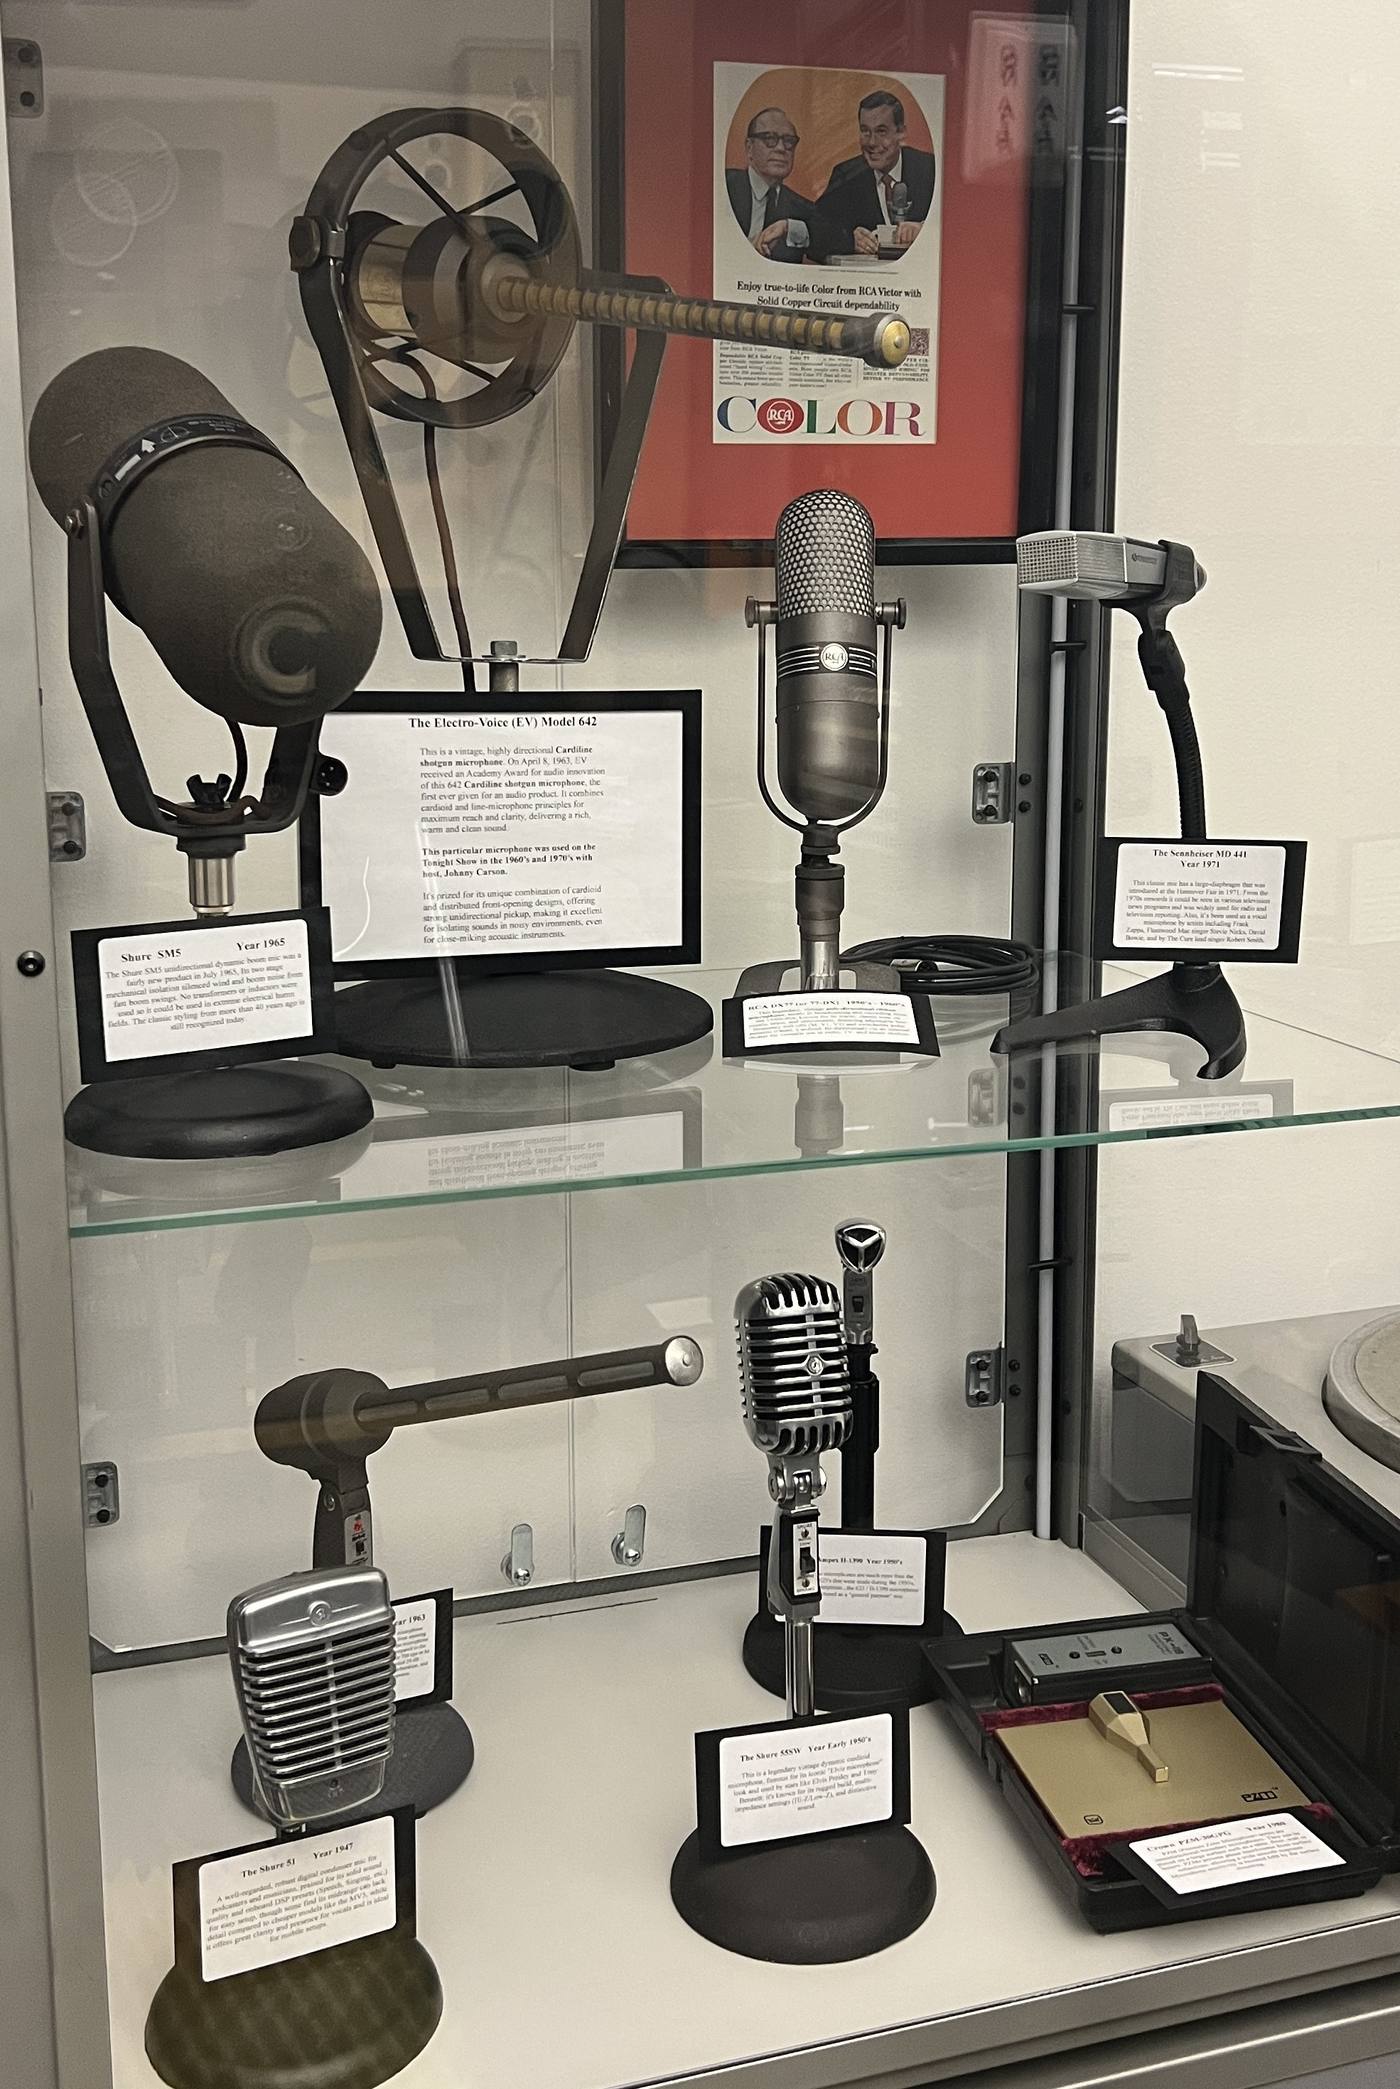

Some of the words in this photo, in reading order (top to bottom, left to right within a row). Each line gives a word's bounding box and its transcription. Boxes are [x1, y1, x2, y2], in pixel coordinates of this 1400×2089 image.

[737, 281, 762, 293] Enjoy
[764, 282, 810, 293] true-to-life
[812, 284, 835, 294] Color
[836, 285, 857, 295] from
[859, 286, 877, 296] RCA
[878, 287, 903, 297] Victor
[904, 288, 922, 298] with
[757, 296, 779, 308] Solid
[781, 297, 812, 309] Copper
[813, 298, 843, 308] Circuit
[844, 300, 900, 311] dependability
[717, 396, 926, 436] COLOR
[767, 408, 793, 423] RCA
[825, 653, 844, 661] RCA
[409, 718, 430, 728] The
[435, 718, 508, 728] Electro-Voice
[512, 717, 538, 728] (EV)
[542, 717, 575, 727] Model
[579, 717, 597, 726] 642
[420, 748, 437, 756] This
[487, 747, 511, 756] highly
[513, 746, 554, 755] directional
[556, 746, 593, 754] Cardiline
[420, 759, 453, 768] shotgun
[521, 758, 541, 767] April
[420, 770, 453, 778] received
[466, 769, 502, 779] Academy
[504, 769, 529, 777] Award
[531, 768, 542, 776] for
[543, 768, 564, 776] audio
[431, 781, 445, 789] this
[447, 781, 462, 789] 642
[464, 780, 503, 788] Cardiline
[505, 780, 536, 789] shotgun
[589, 778, 601, 786] the
[421, 792, 437, 800] first
[458, 792, 479, 802] given
[481, 791, 493, 799] for
[505, 791, 527, 799] audio
[569, 789, 604, 797] combines
[421, 804, 453, 812] cardioid
[455, 803, 469, 811] and
[471, 802, 533, 811] line-microphone
[535, 801, 572, 811] principles
[573, 800, 584, 808] for
[462, 814, 483, 822] reach
[528, 812, 567, 822] delivering
[445, 825, 460, 833] and
[461, 825, 482, 833] clean
[422, 848, 440, 856] This
[442, 847, 483, 856] particular
[486, 846, 532, 854] microphone
[423, 859, 454, 868] Tonight
[506, 856, 530, 864] 1960's
[532, 855, 547, 863] and
[550, 854, 574, 862] 1970's
[444, 869, 474, 877] Johnny
[476, 868, 508, 876] Carson.
[121, 952, 152, 962] Shure
[158, 949, 181, 958] SM5
[237, 941, 260, 951] Year
[264, 938, 285, 948] 1965
[740, 1754, 754, 1762] The
[756, 1751, 778, 1760] Shure
[808, 1744, 825, 1752] Year
[828, 1741, 847, 1749] Early
[240, 1868, 257, 1878] The
[259, 1861, 284, 1873] Shure
[286, 1858, 295, 1867] 51
[313, 1849, 332, 1860] Year
[336, 1842, 353, 1854] 1947
